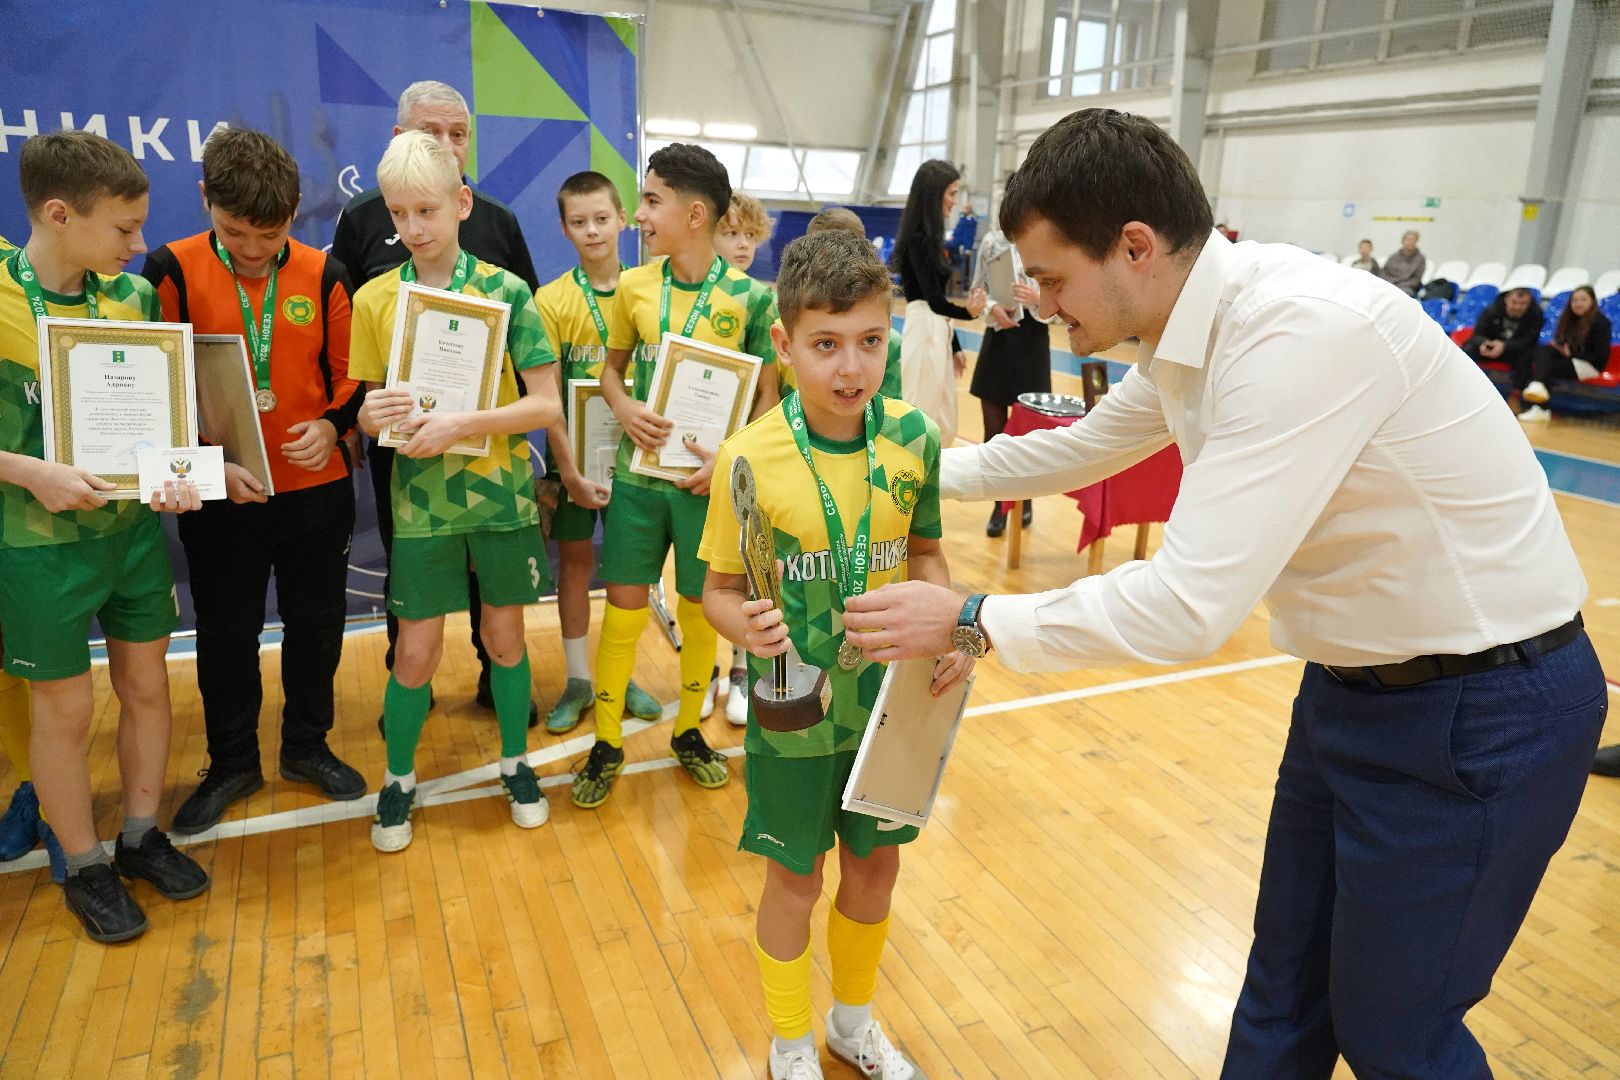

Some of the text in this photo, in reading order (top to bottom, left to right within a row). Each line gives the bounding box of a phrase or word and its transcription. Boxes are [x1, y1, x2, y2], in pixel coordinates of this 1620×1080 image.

[684, 291, 708, 333] СЕЗОН 2024
[260, 313, 272, 362] СЕЗОН 2024
[527, 556, 540, 589] 3
[854, 534, 867, 574] СЕЗОН
